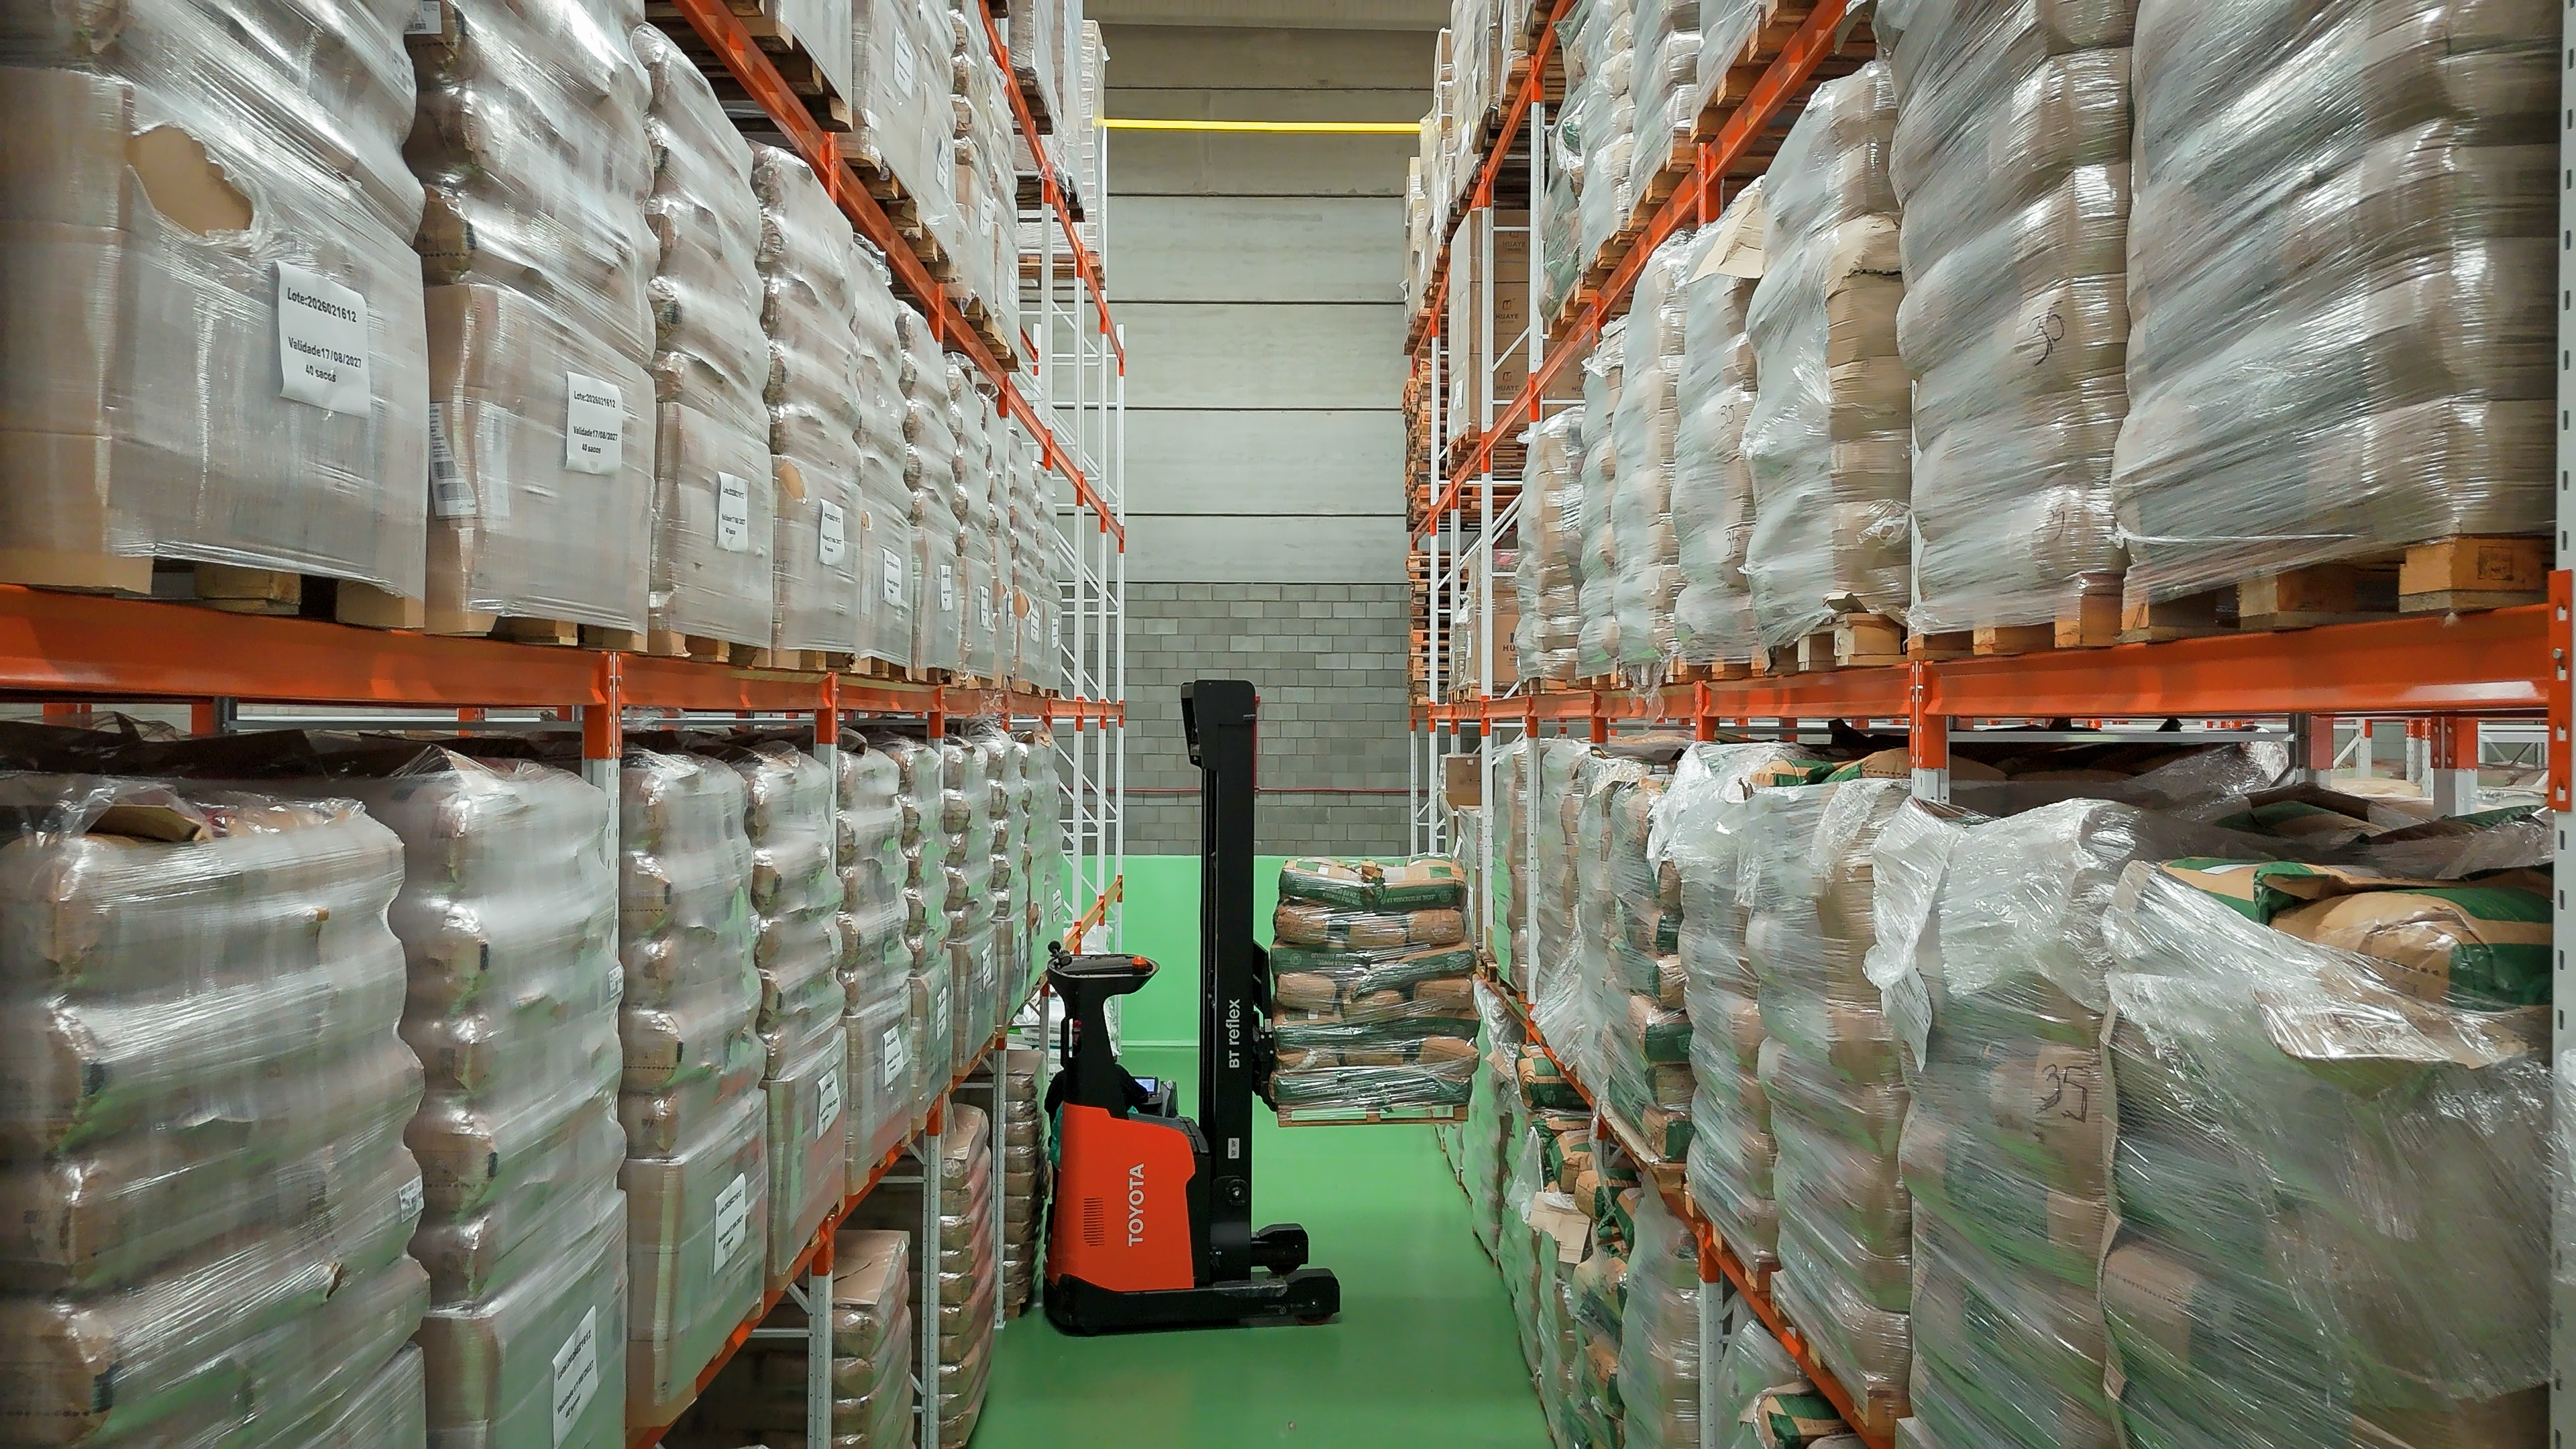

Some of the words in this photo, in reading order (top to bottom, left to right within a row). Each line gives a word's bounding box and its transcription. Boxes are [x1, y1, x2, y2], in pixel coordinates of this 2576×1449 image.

[287, 286, 357, 323] Lote:2026021612
[305, 364, 314, 376] 40
[315, 368, 337, 383] sacos
[1720, 404, 1735, 430] 35
[1226, 998, 1240, 1045] reflex
[1229, 1050, 1240, 1068] BT
[2035, 1063, 2091, 1123] 35
[1128, 1163, 1144, 1247] TOYOTA
